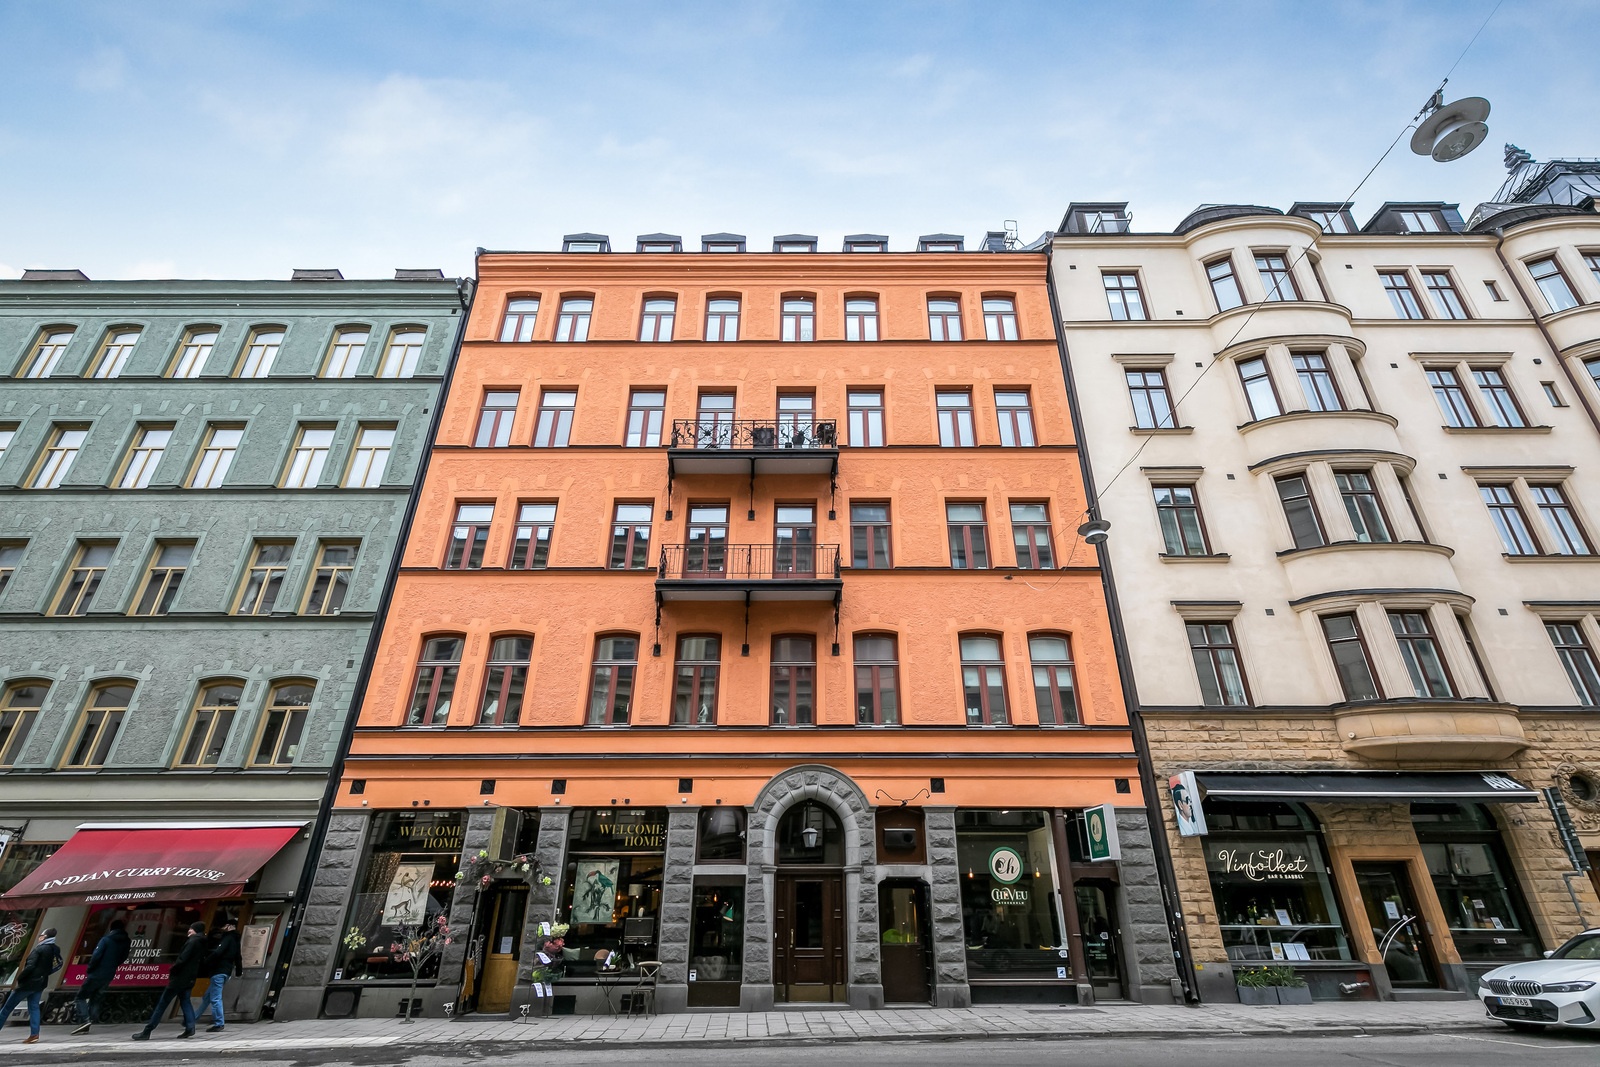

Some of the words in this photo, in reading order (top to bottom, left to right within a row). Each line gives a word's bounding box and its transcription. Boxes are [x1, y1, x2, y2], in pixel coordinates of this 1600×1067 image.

[400, 825, 464, 837] WELCOME
[600, 824, 664, 835] WELCOME
[423, 837, 462, 849] HOME
[624, 835, 663, 847] HOME
[1218, 848, 1308, 882] Vinfolket
[40, 869, 115, 892] INDIAN
[115, 866, 177, 878] CURRY
[173, 867, 226, 882] HOUSE
[85, 893, 110, 902] INDIAN
[109, 892, 133, 900] CURRY
[133, 891, 157, 899] HOUSE
[130, 939, 152, 948] DIAN
[133, 948, 162, 957] HOUSE
[116, 964, 160, 972] VHÄMTNING
